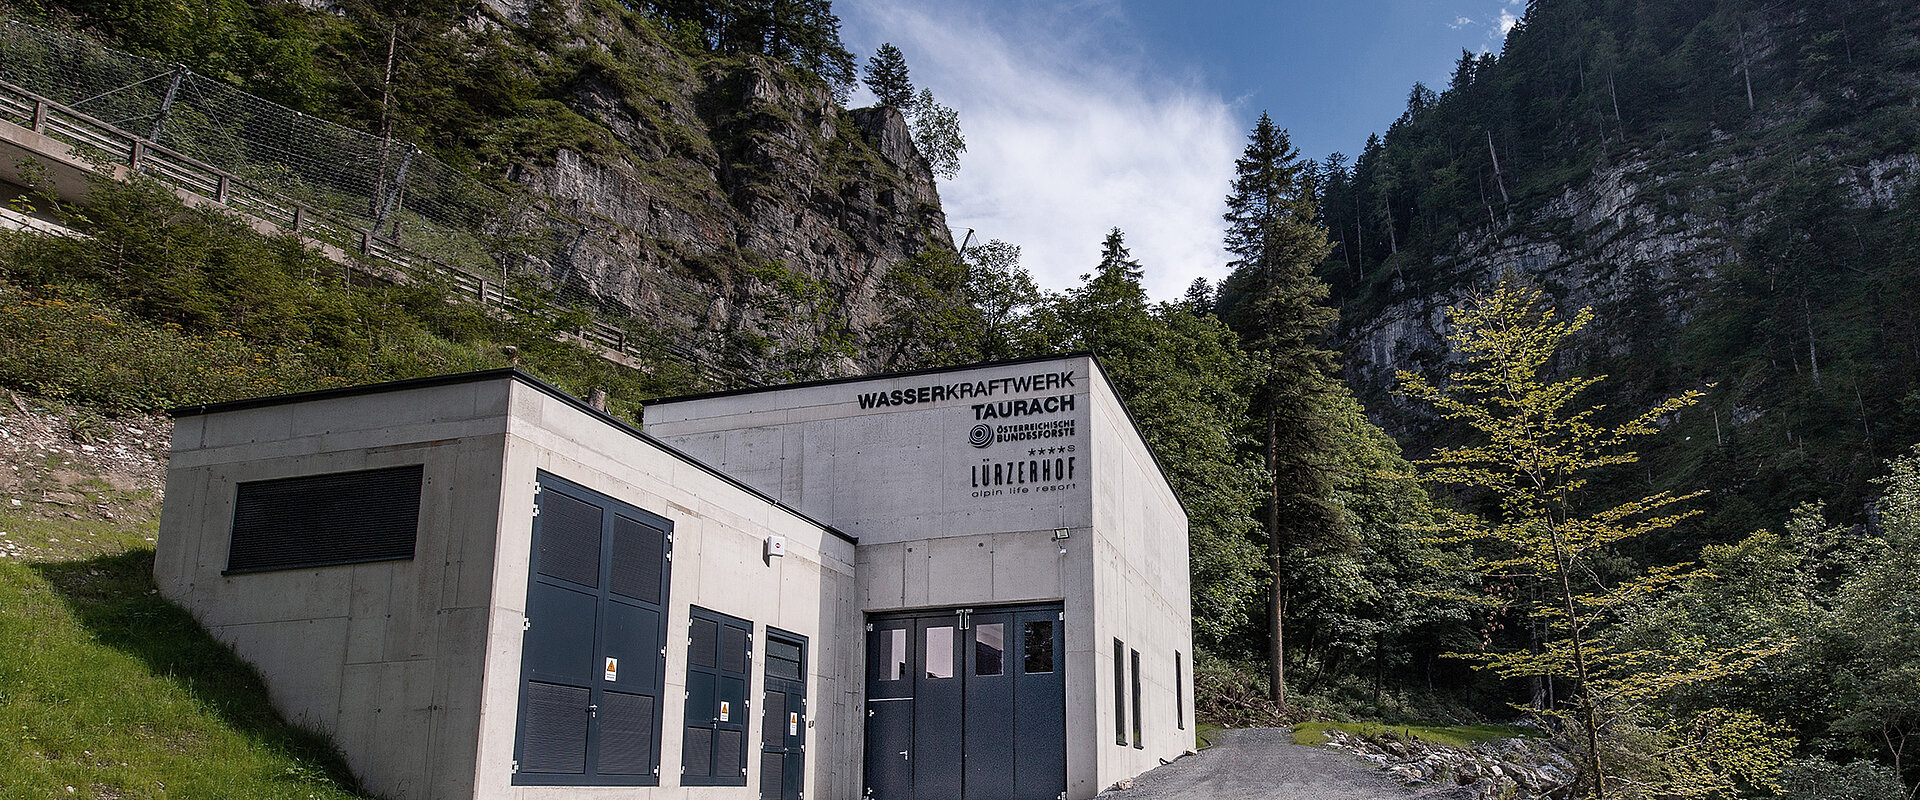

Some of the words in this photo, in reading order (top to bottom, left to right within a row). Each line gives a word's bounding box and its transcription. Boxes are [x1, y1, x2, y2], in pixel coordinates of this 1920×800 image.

[857, 370, 1075, 409] WASSERKRAFTWERK
[971, 394, 1075, 420] TAURACH
[996, 419, 1075, 434] ÖSTERREICHISCHE
[996, 427, 1075, 443] BUNDESFORSTE
[971, 456, 1076, 487] LÜRZERHOF
[971, 488, 1003, 498] alpin
[1009, 486, 1029, 495] life
[1035, 482, 1076, 493] resort
